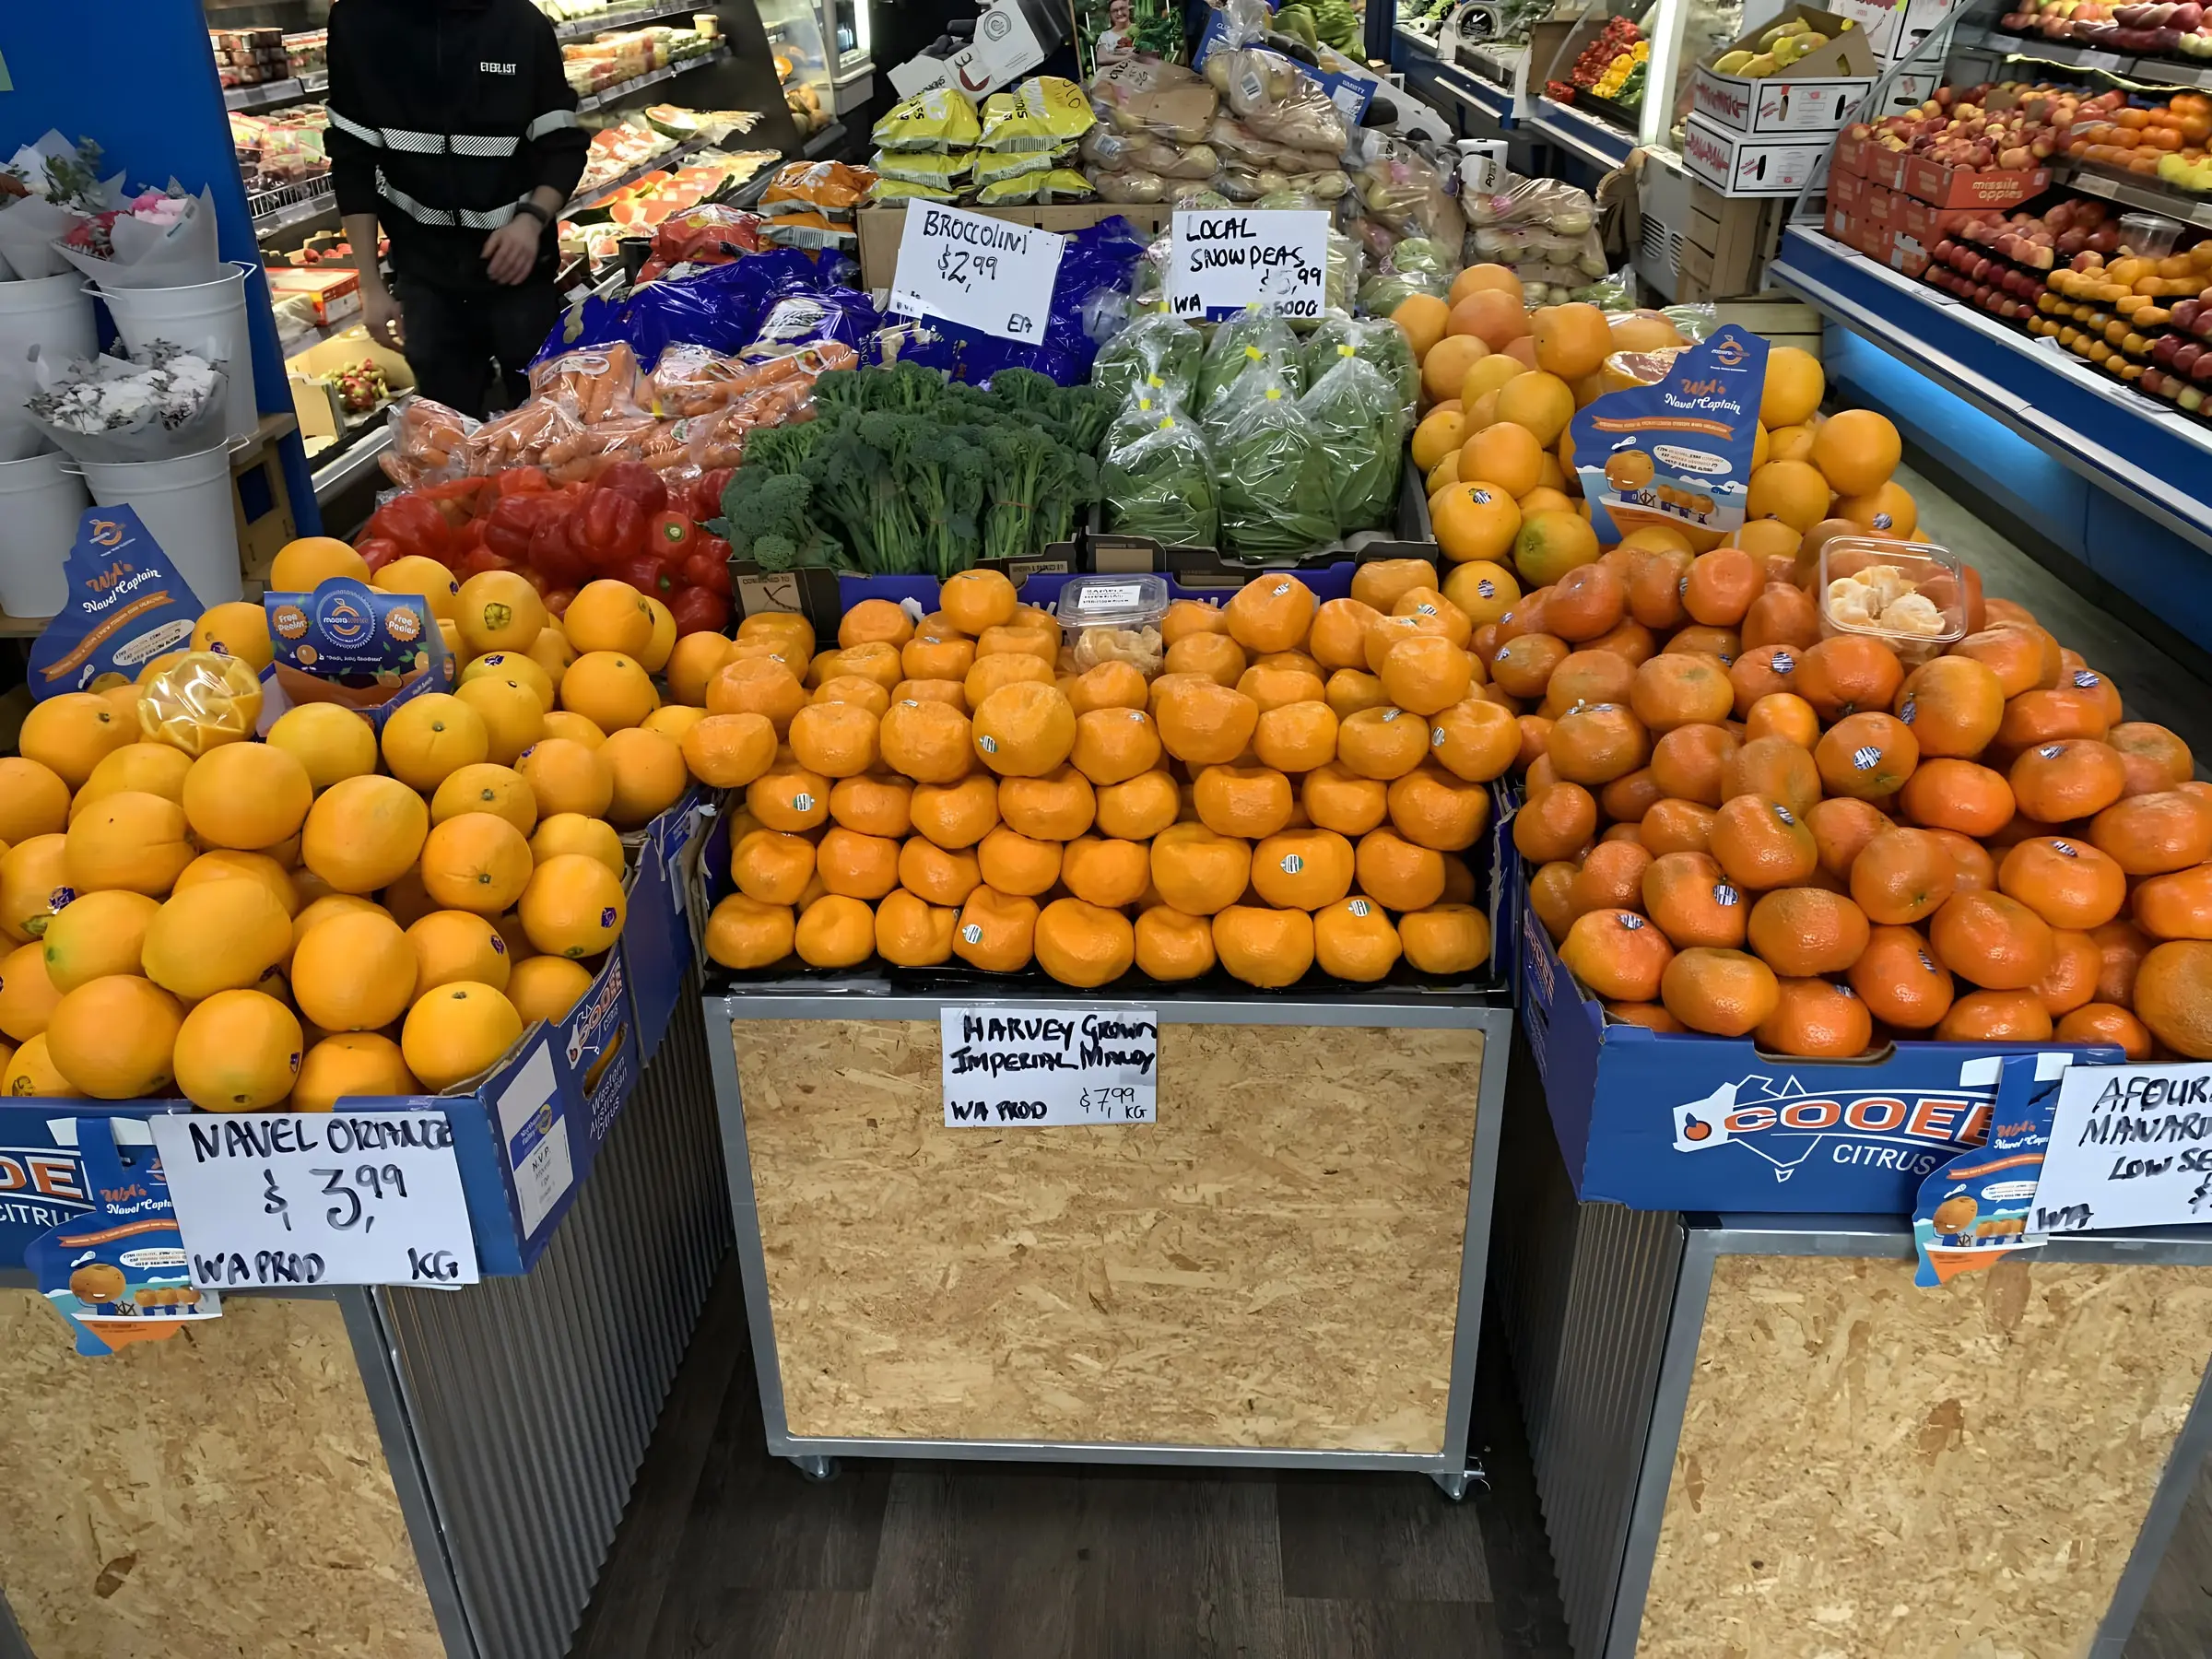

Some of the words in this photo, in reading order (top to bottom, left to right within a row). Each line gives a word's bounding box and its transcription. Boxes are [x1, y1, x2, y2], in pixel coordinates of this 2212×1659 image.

[923, 210, 1028, 255] BROCCOLINI
[1186, 214, 1257, 241] LOCAL
[1174, 293, 1202, 314] WA
[1665, 393, 1697, 410] Navel
[1698, 397, 1742, 415] Captain
[83, 591, 117, 613] Navel
[114, 568, 161, 594] Captain
[963, 1015, 1076, 1051] HARVEY
[951, 1100, 988, 1122] WA
[1125, 1106, 1147, 1119] KG
[189, 1119, 319, 1162] NAVEL
[1833, 1144, 1936, 1175] CITRUS
[2108, 1156, 2174, 1181] LOW
[106, 1203, 139, 1215] Navel
[194, 1253, 251, 1284] WA
[255, 1250, 326, 1284] PROD
[408, 1248, 459, 1281] KG
